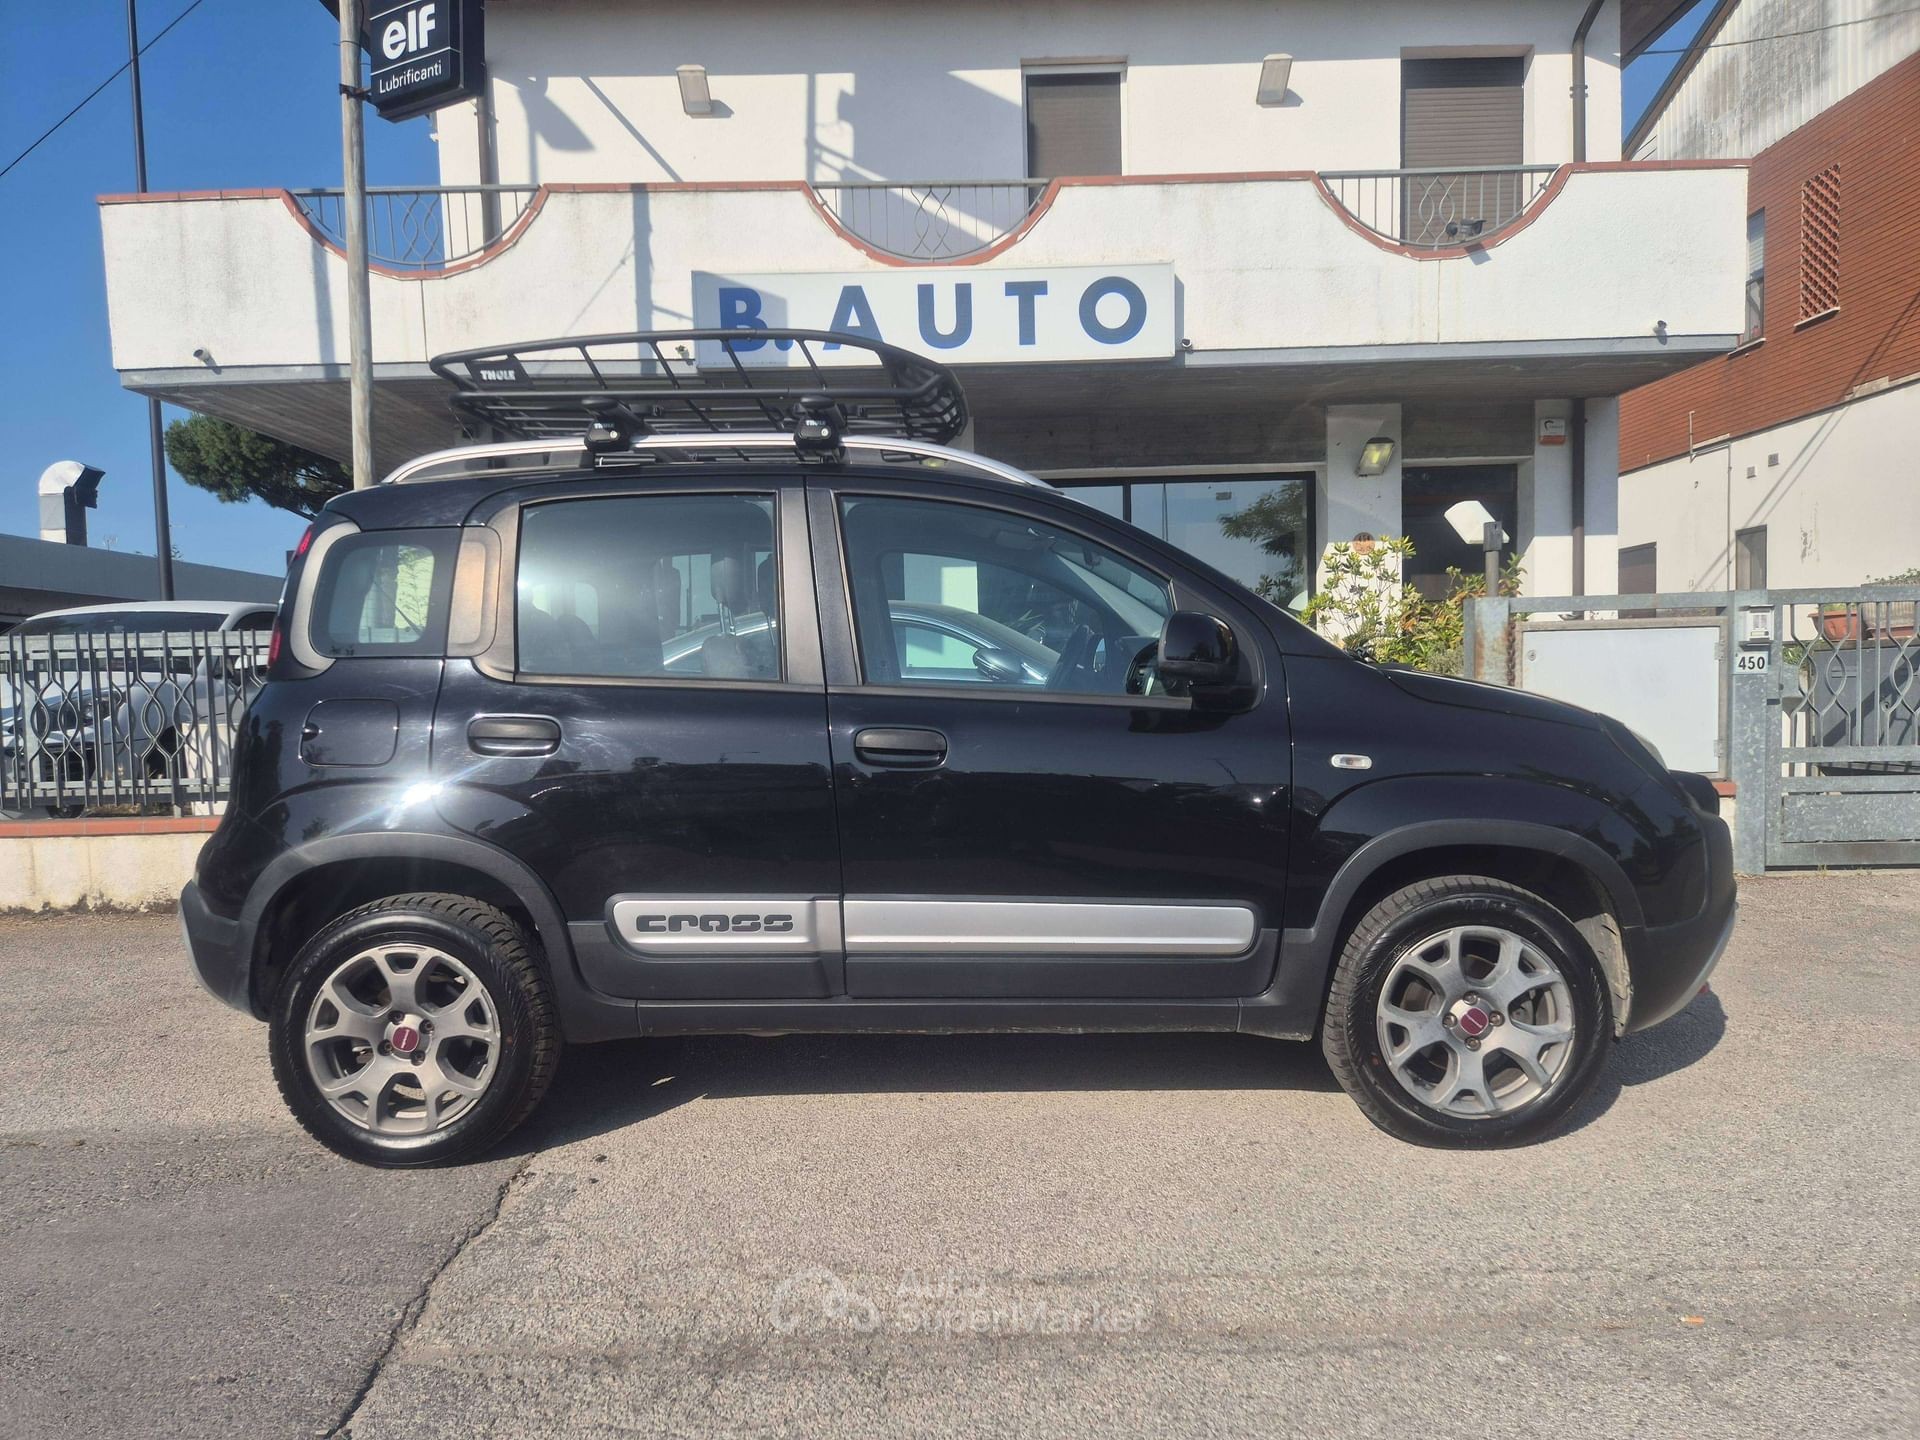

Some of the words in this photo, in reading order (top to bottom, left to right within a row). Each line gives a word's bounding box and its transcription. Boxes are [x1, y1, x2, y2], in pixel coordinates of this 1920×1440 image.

[383, 3, 436, 60] elf
[380, 60, 442, 94] Lubrificanti
[480, 370, 516, 381] THULE
[1738, 656, 1765, 670] 450
